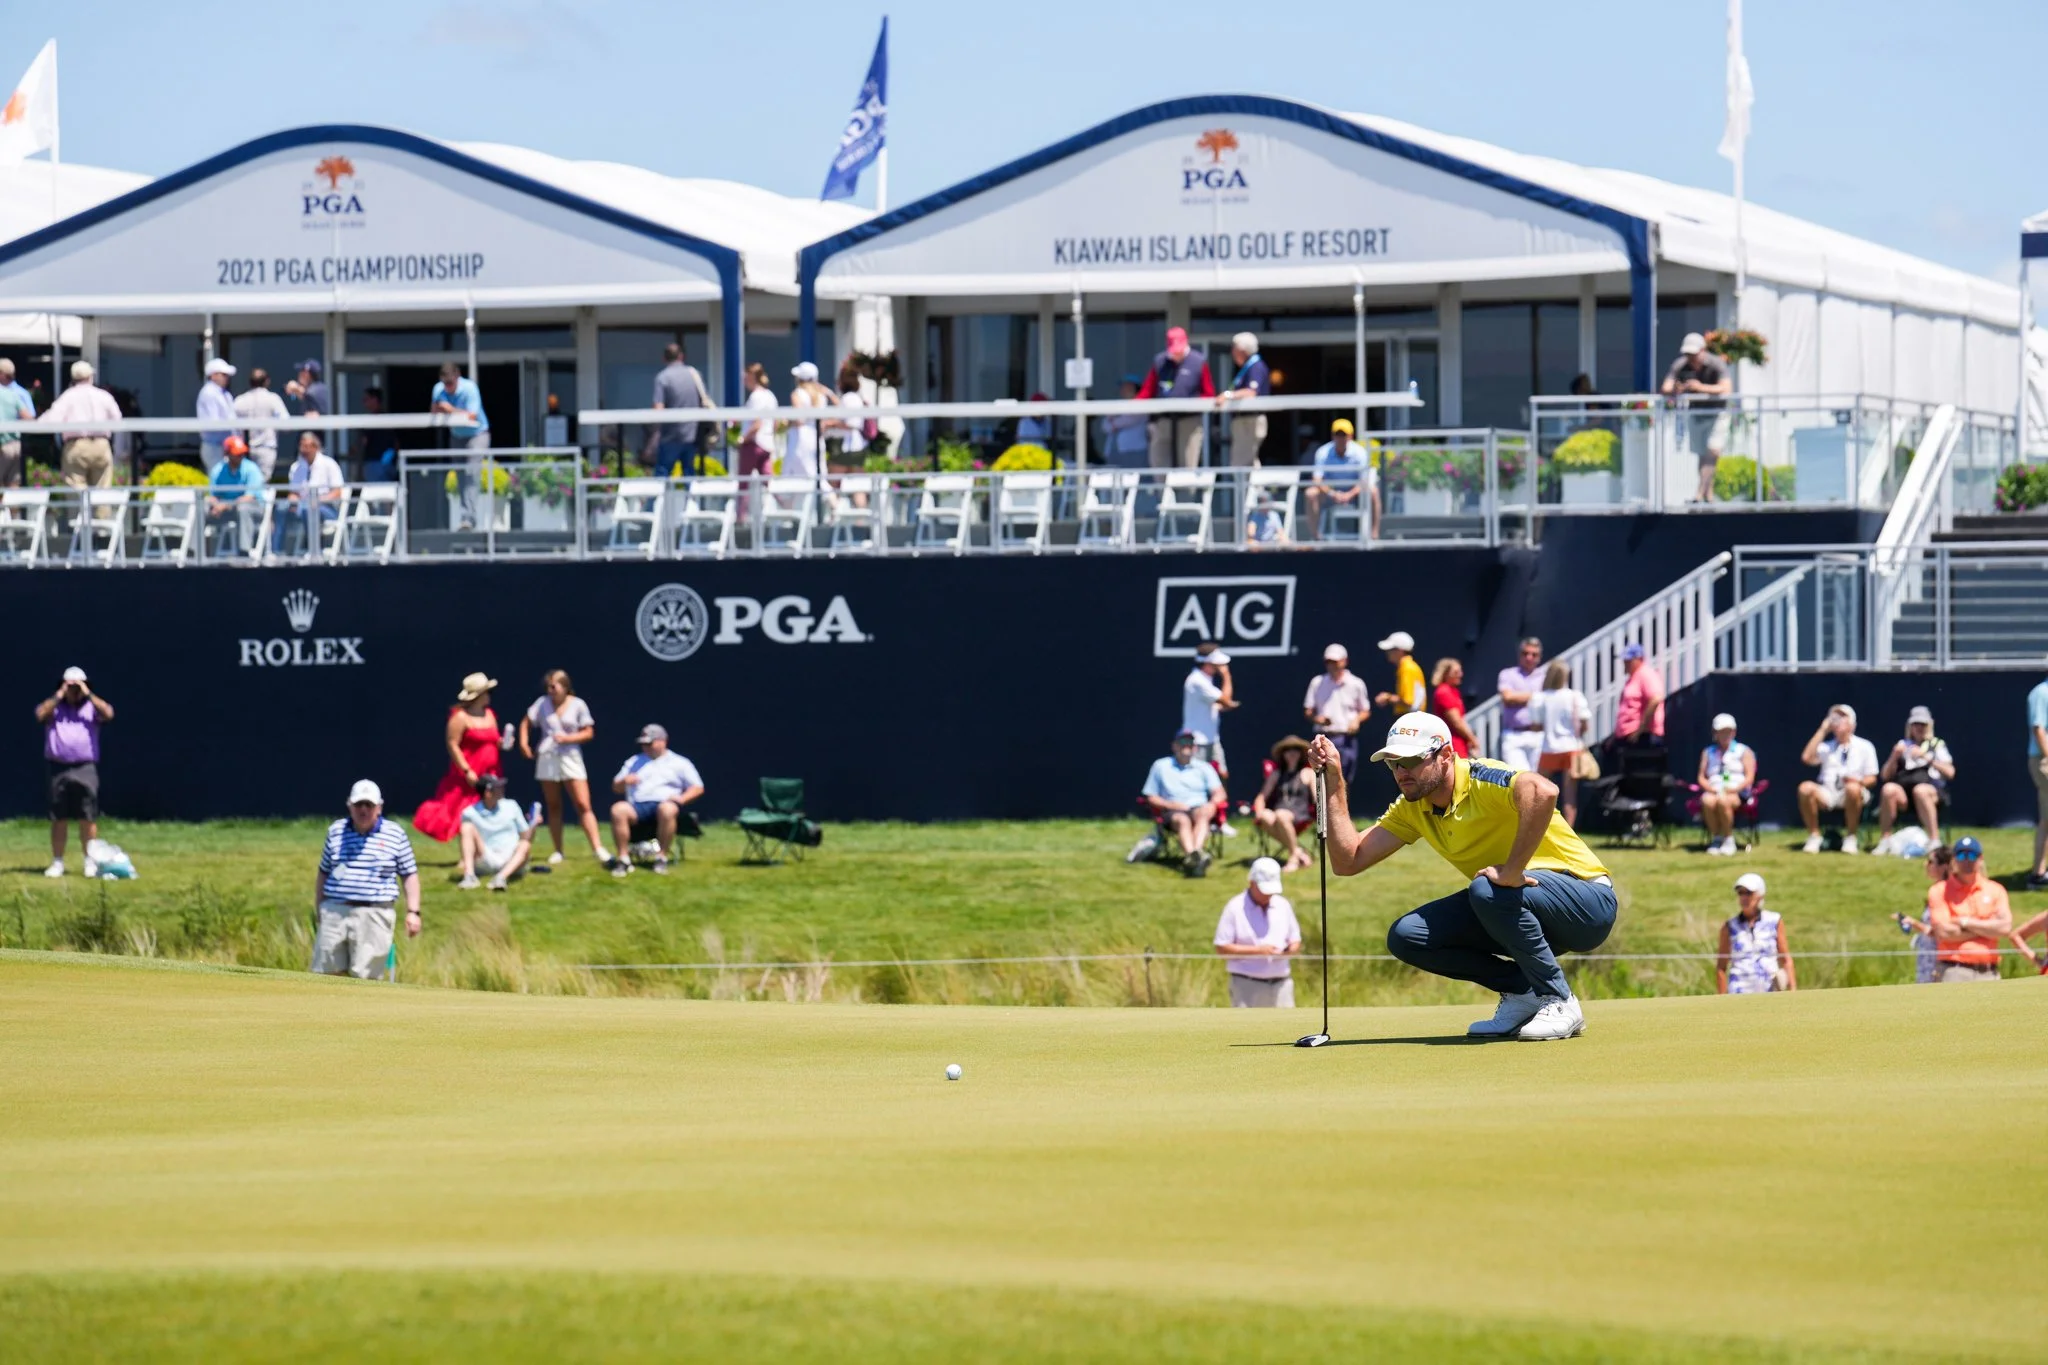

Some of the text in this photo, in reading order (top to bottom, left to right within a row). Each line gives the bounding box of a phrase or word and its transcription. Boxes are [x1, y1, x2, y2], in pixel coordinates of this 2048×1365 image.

[1183, 168, 1248, 190] PGA
[302, 194, 364, 216] PGA
[1054, 228, 1391, 265] KIAWAH ISLAND GOLF RESORT
[217, 252, 485, 286] 2021 PGA CHAMPIONSHIP
[712, 595, 867, 645] PGA
[1169, 591, 1275, 641] AIG
[238, 637, 365, 667] ROLEX
